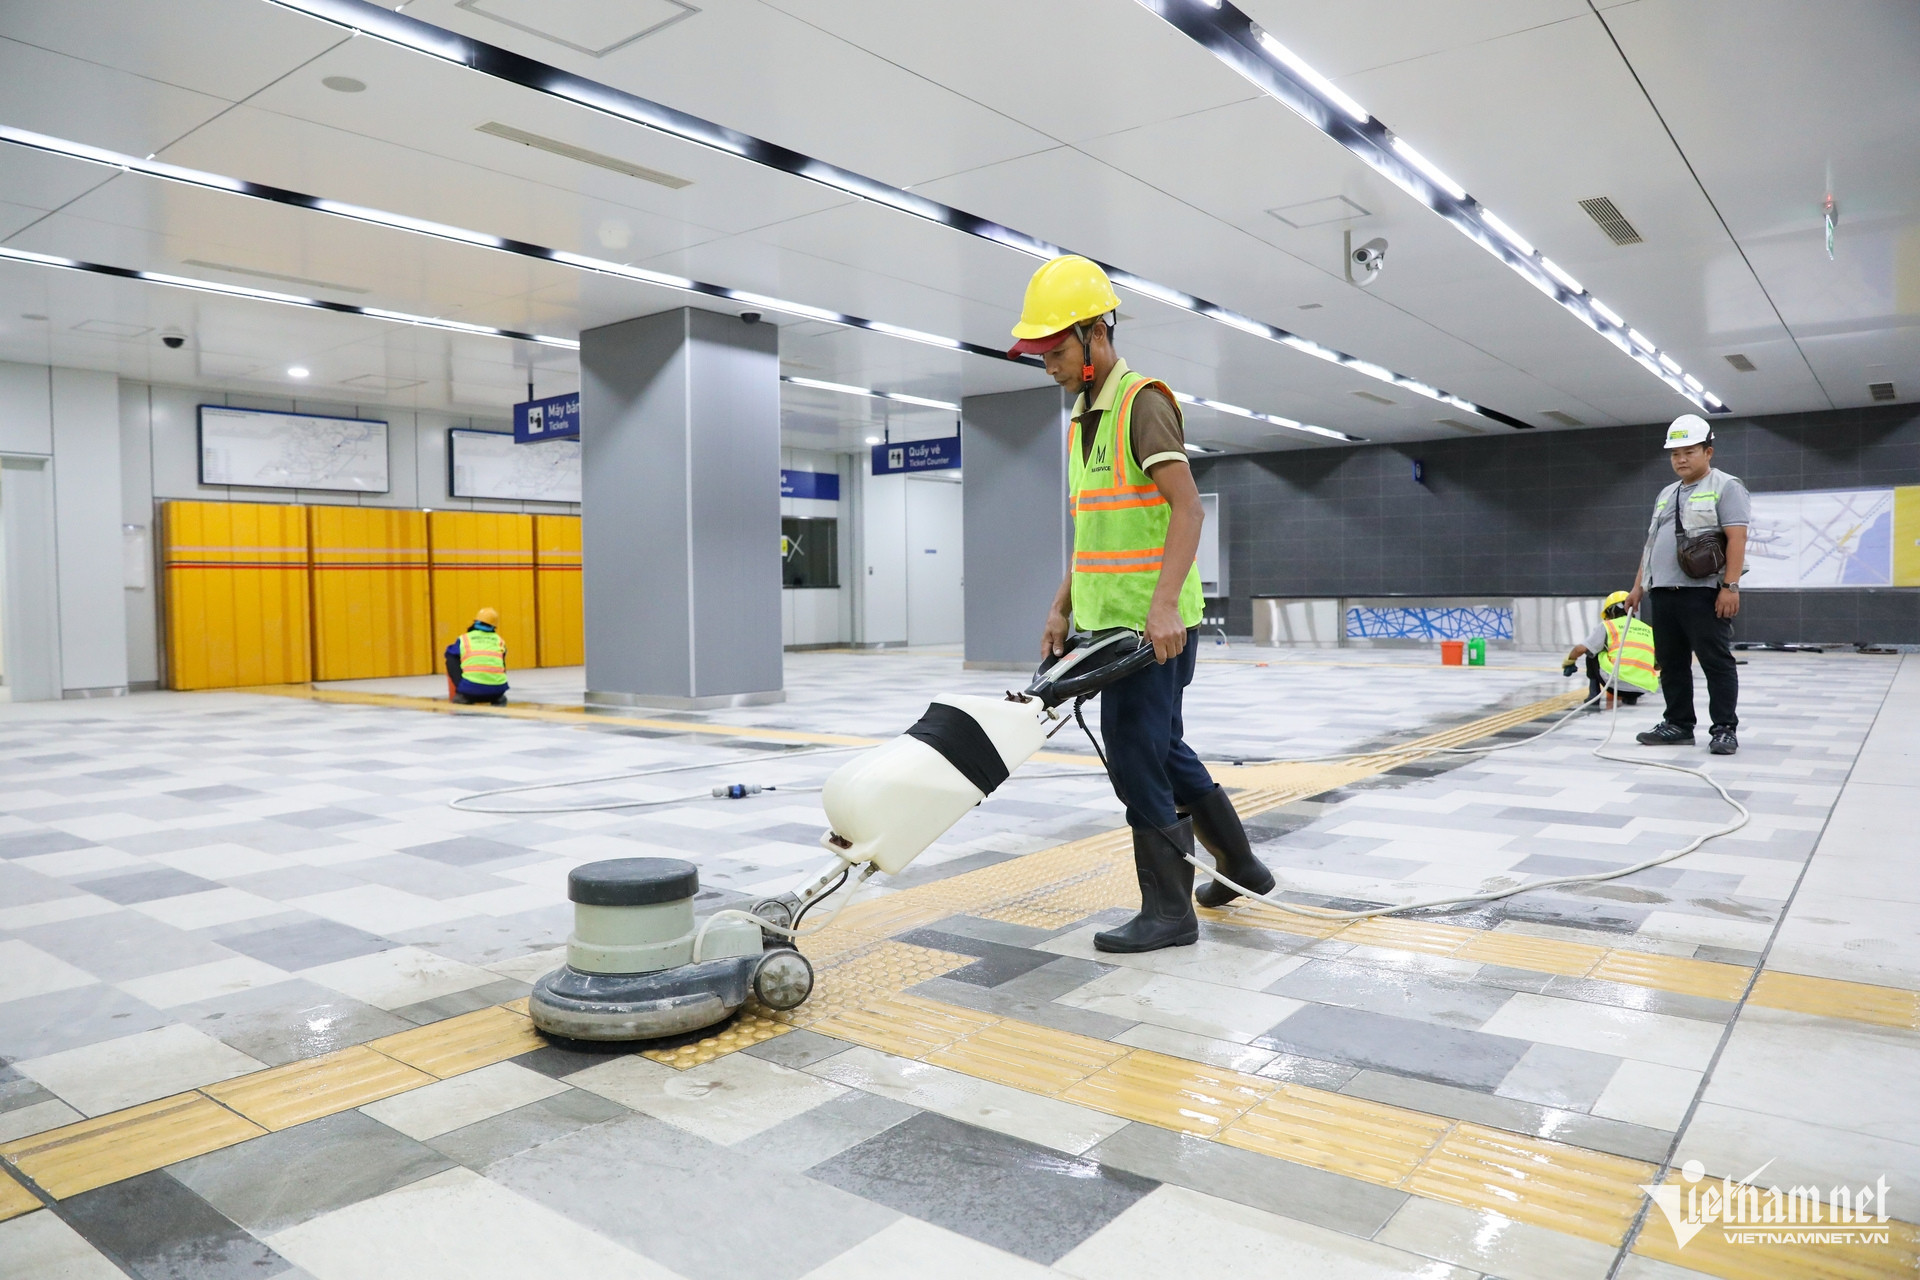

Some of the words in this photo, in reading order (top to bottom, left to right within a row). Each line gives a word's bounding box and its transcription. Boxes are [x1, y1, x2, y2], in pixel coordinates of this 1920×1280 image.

[548, 403, 565, 419] Máy
[549, 420, 569, 431] Tickets
[909, 458, 926, 467] Ticket
[927, 457, 949, 466] Counter
